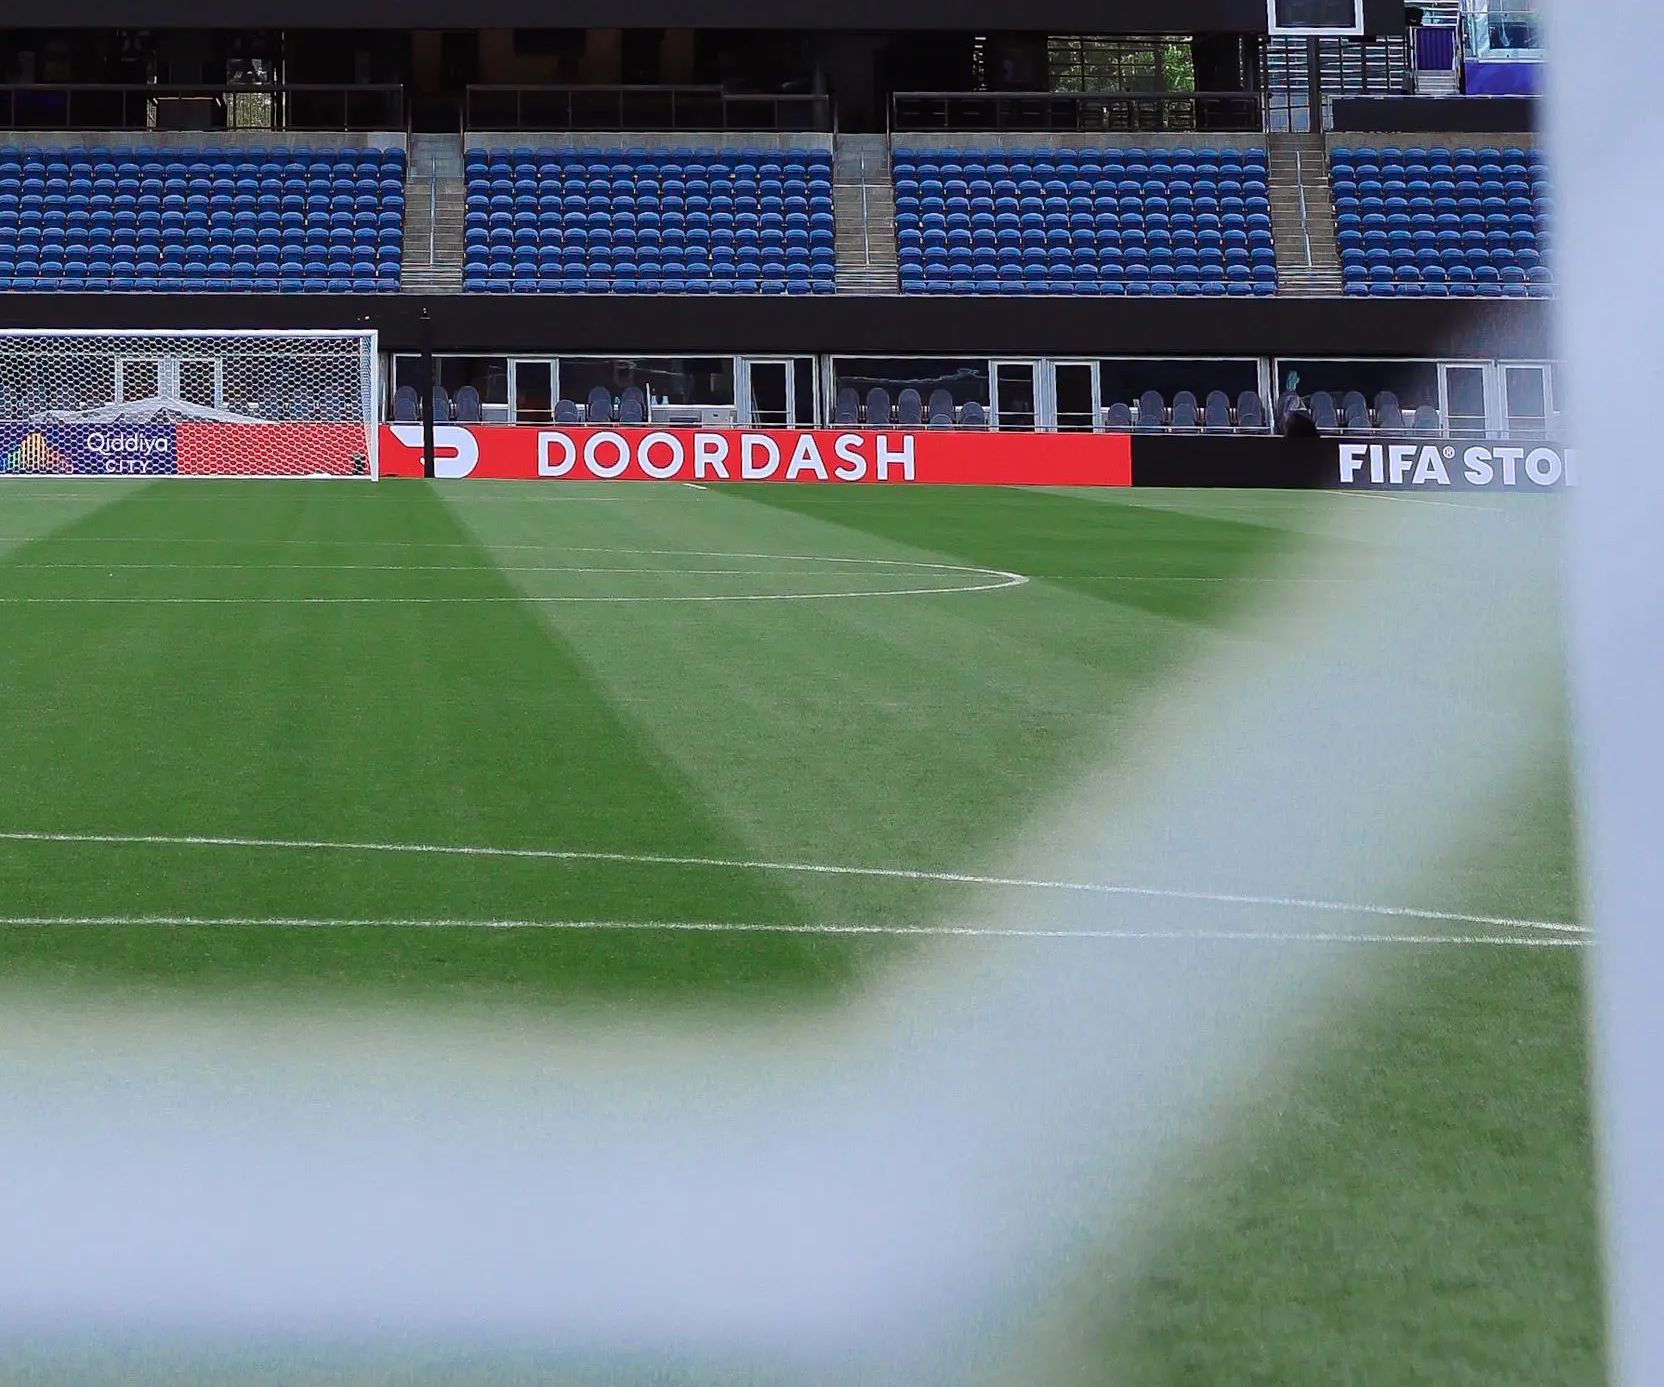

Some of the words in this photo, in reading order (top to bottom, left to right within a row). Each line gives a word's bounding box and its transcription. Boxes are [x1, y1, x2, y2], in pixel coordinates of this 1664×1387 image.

[87, 432, 169, 456] Qiddiya
[537, 431, 916, 482] DOORDASH
[105, 460, 149, 473] CITY
[1463, 446, 1580, 487] STO
